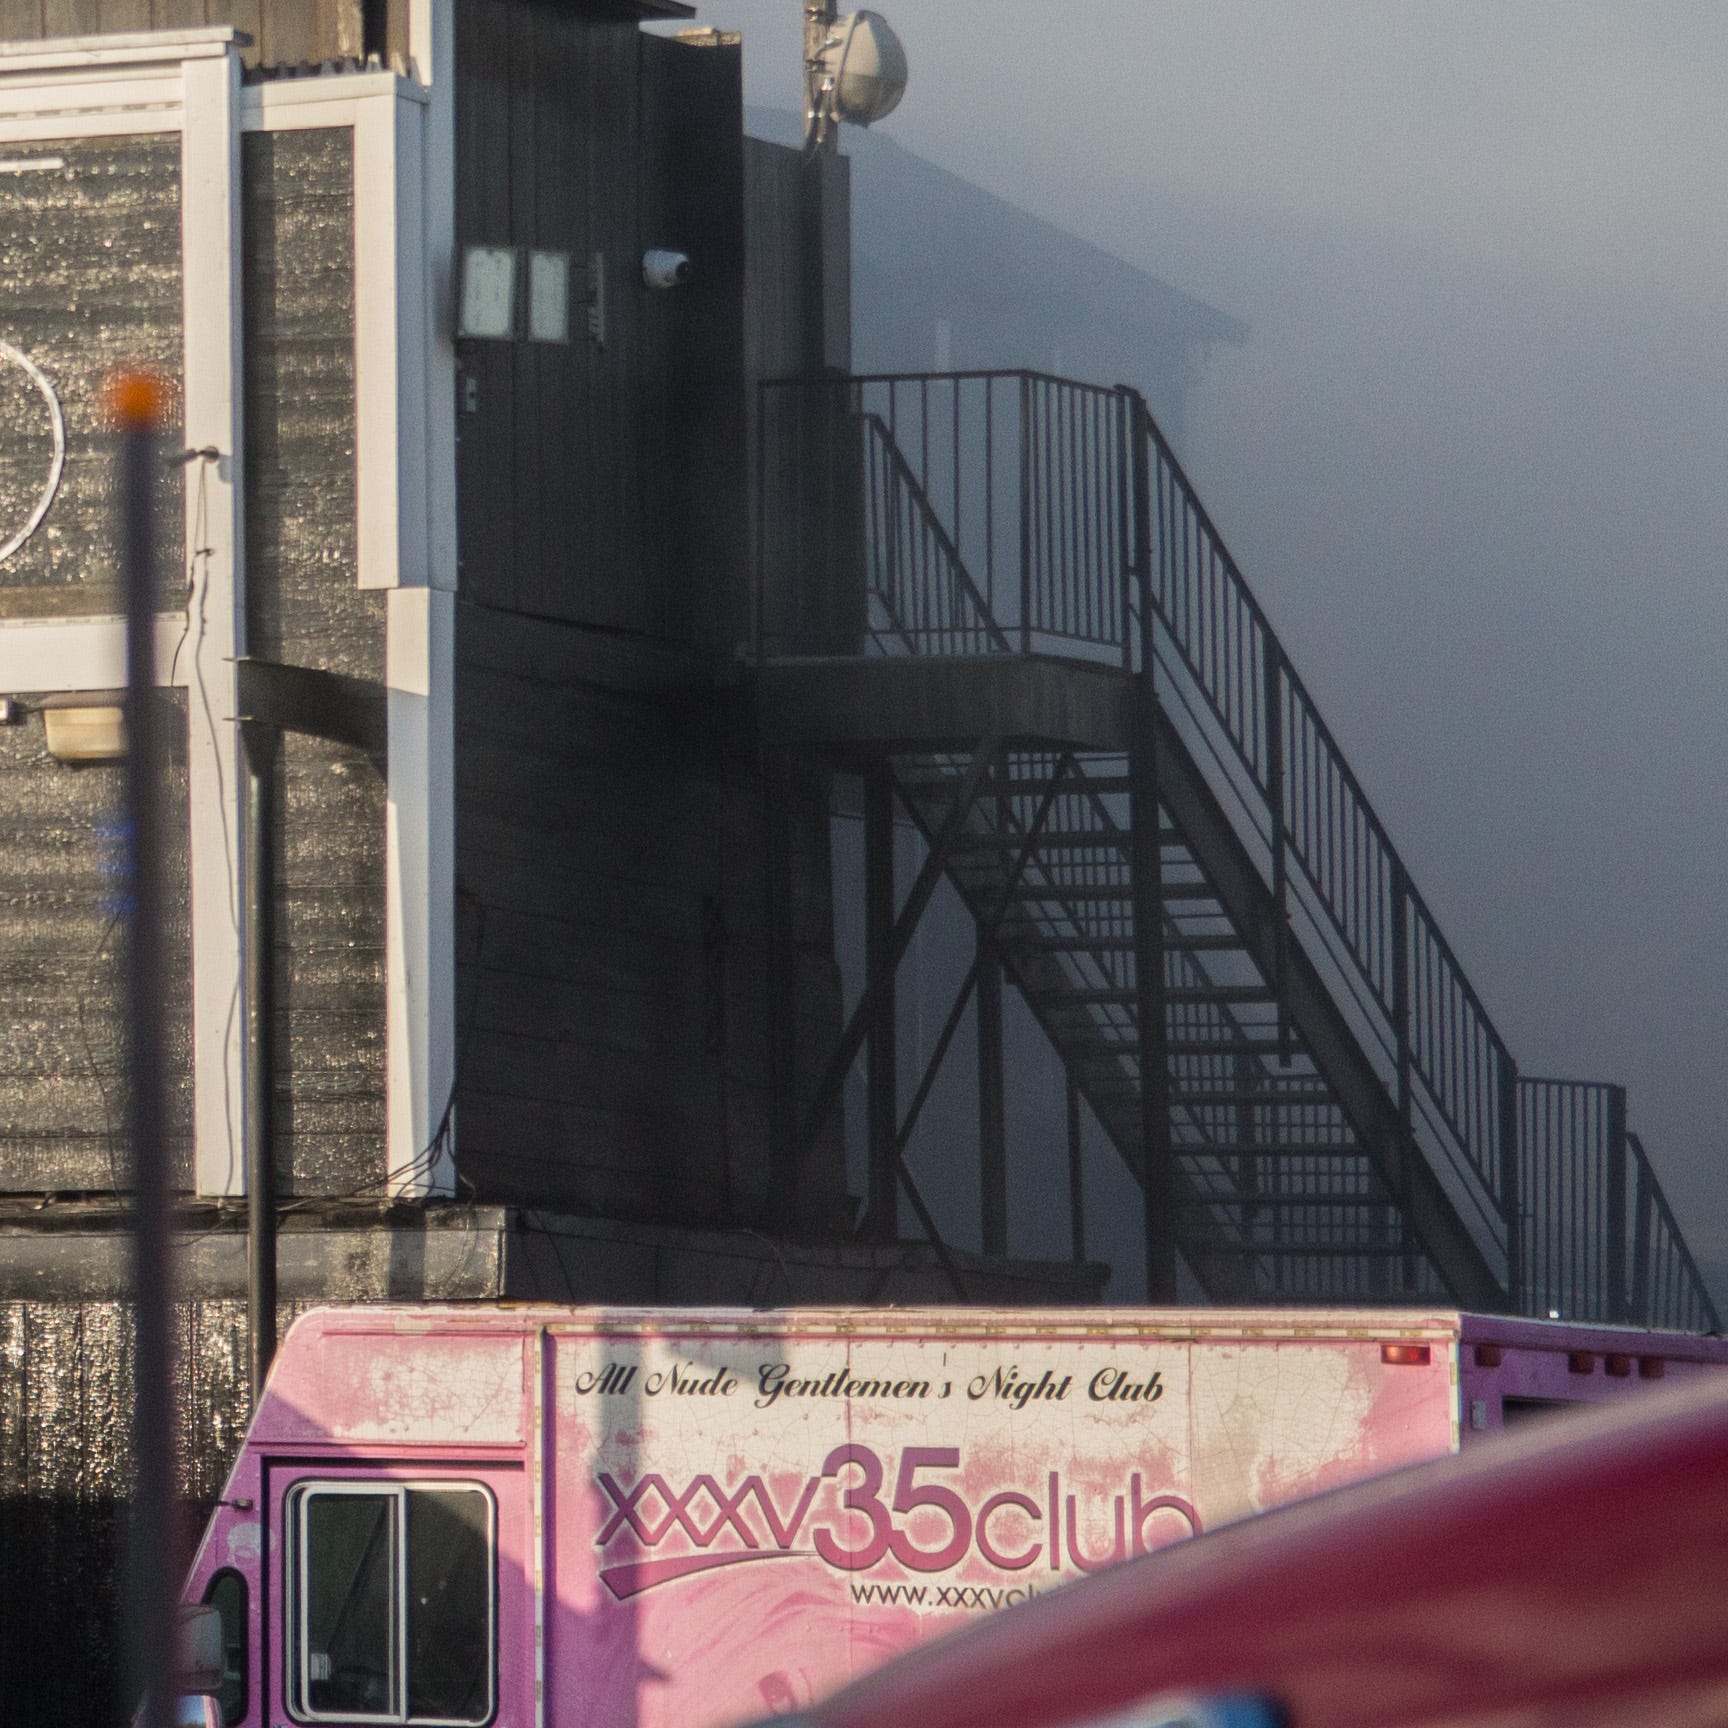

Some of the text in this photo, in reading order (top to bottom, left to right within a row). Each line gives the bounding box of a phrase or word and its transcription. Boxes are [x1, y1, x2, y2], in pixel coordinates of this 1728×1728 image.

[575, 1362, 638, 1395] All
[644, 1361, 739, 1397] Nude
[966, 1365, 1073, 1410] Night
[1087, 1367, 1164, 1402] Club
